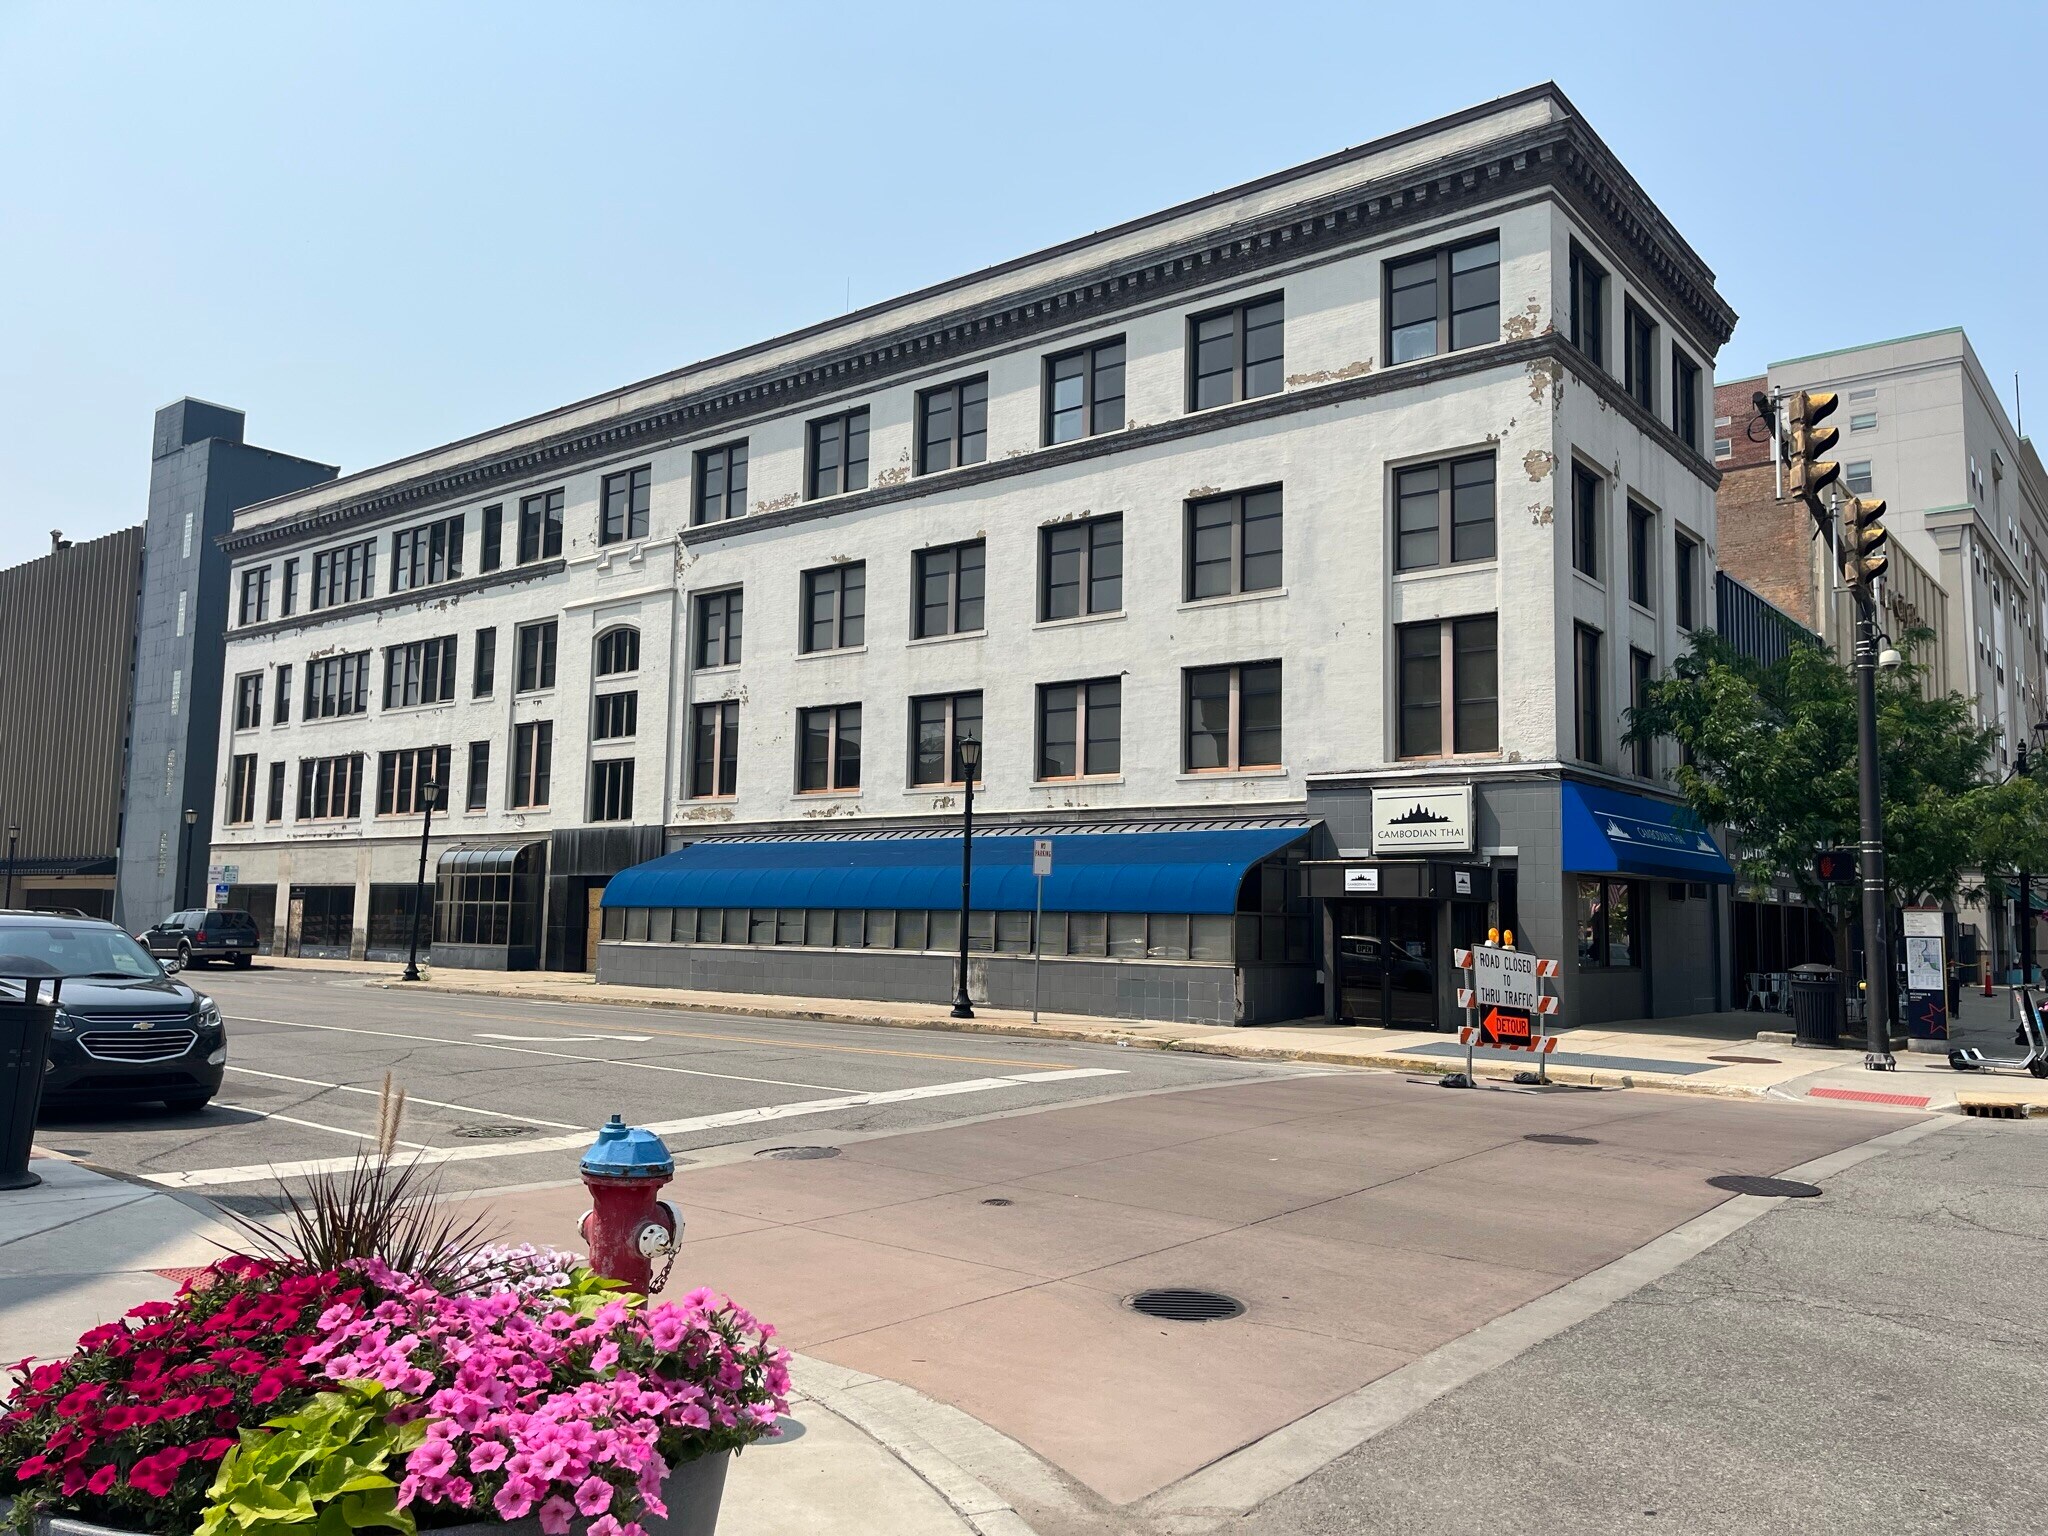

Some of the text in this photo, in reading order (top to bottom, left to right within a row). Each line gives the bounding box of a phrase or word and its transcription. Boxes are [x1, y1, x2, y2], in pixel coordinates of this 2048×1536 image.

[1377, 828, 1464, 839] CAMBODIAN THAI
[1357, 945, 1372, 953] OPEN
[1480, 953, 1532, 973] ROAD CLOSED
[1503, 974, 1511, 986] TO
[1481, 988, 1533, 1007] THRU TRAFFIC
[1496, 1018, 1527, 1034] DETOUR
